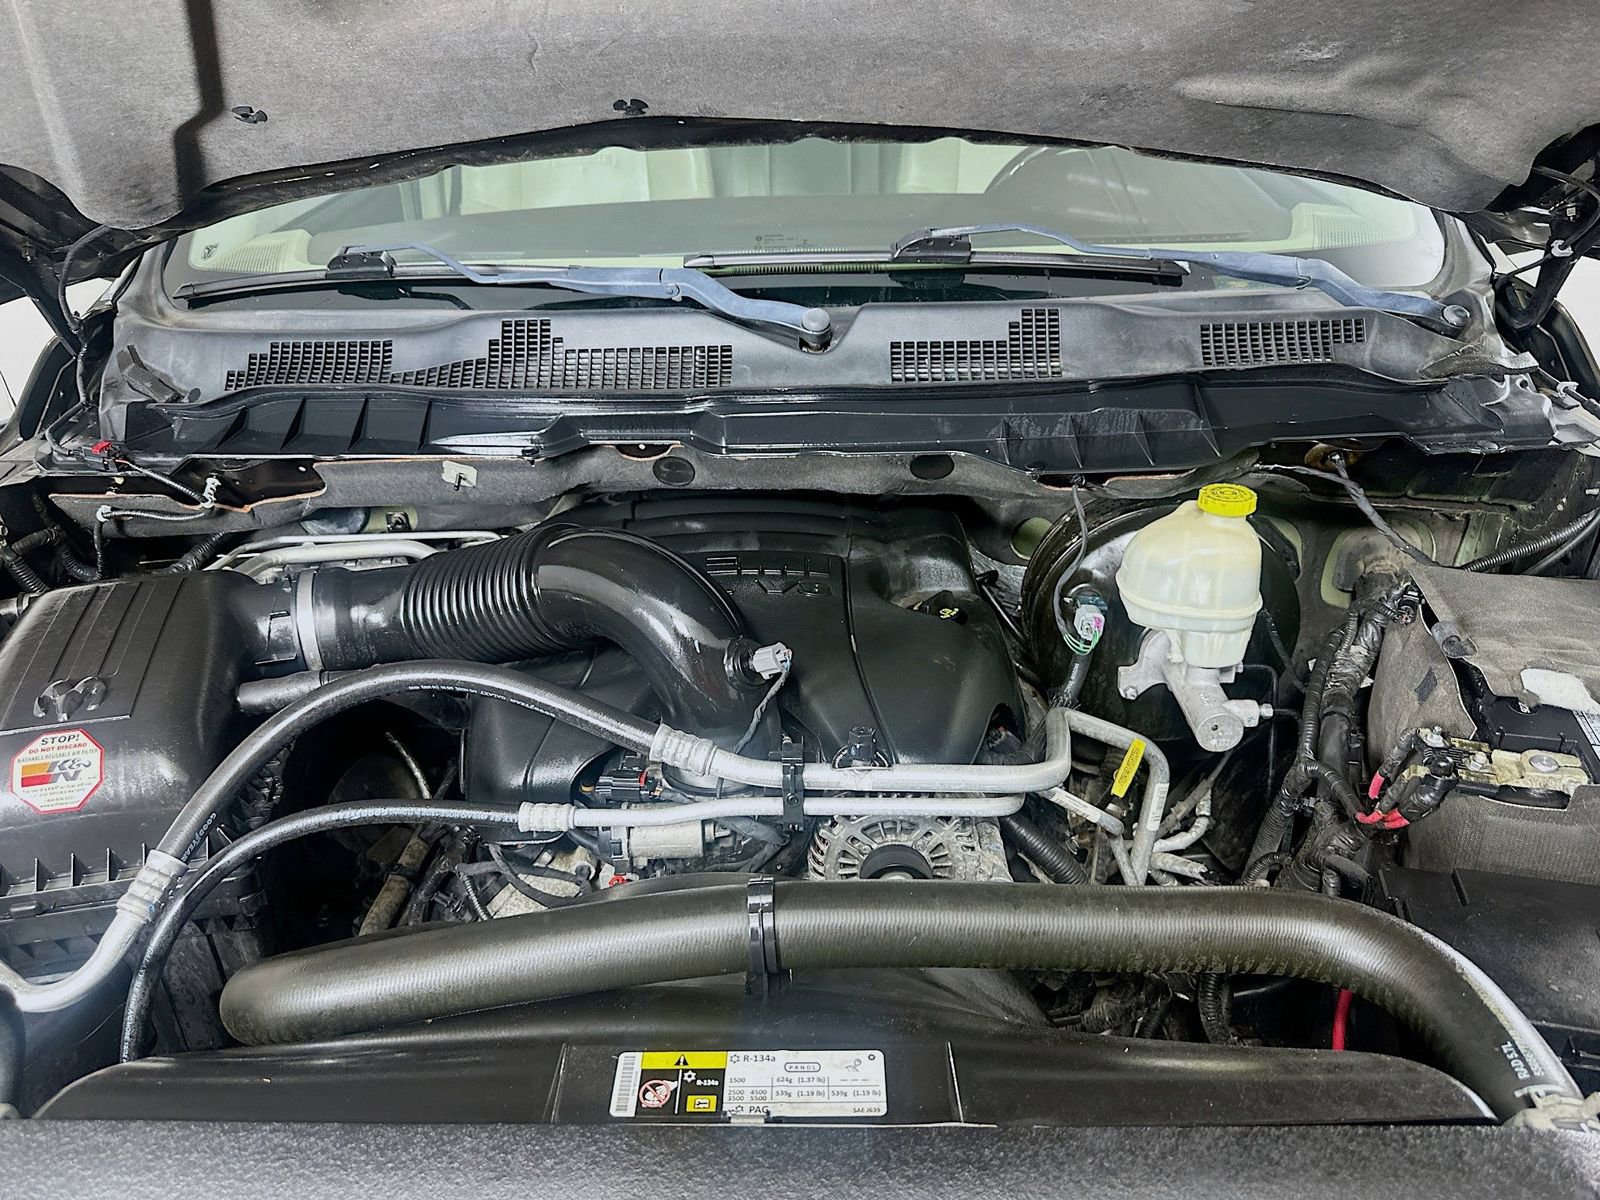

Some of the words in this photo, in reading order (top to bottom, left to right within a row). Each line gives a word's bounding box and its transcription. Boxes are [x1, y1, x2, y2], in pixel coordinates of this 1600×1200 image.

[41, 734, 80, 745] STOP!
[56, 743, 88, 751] DISCARD
[181, 812, 217, 862] GOODYEAR
[1501, 1041, 1518, 1059] 5.7L
[742, 1054, 776, 1063] R-134a
[1511, 1060, 1529, 1079] RAD
[776, 1075, 793, 1084] 624g
[798, 1075, 816, 1084] (1.37
[775, 1090, 793, 1098] 539g
[796, 1089, 815, 1098] (1.19
[831, 1090, 848, 1098] 539g
[852, 1089, 871, 1097] (1.19
[748, 1105, 769, 1114] PAG
